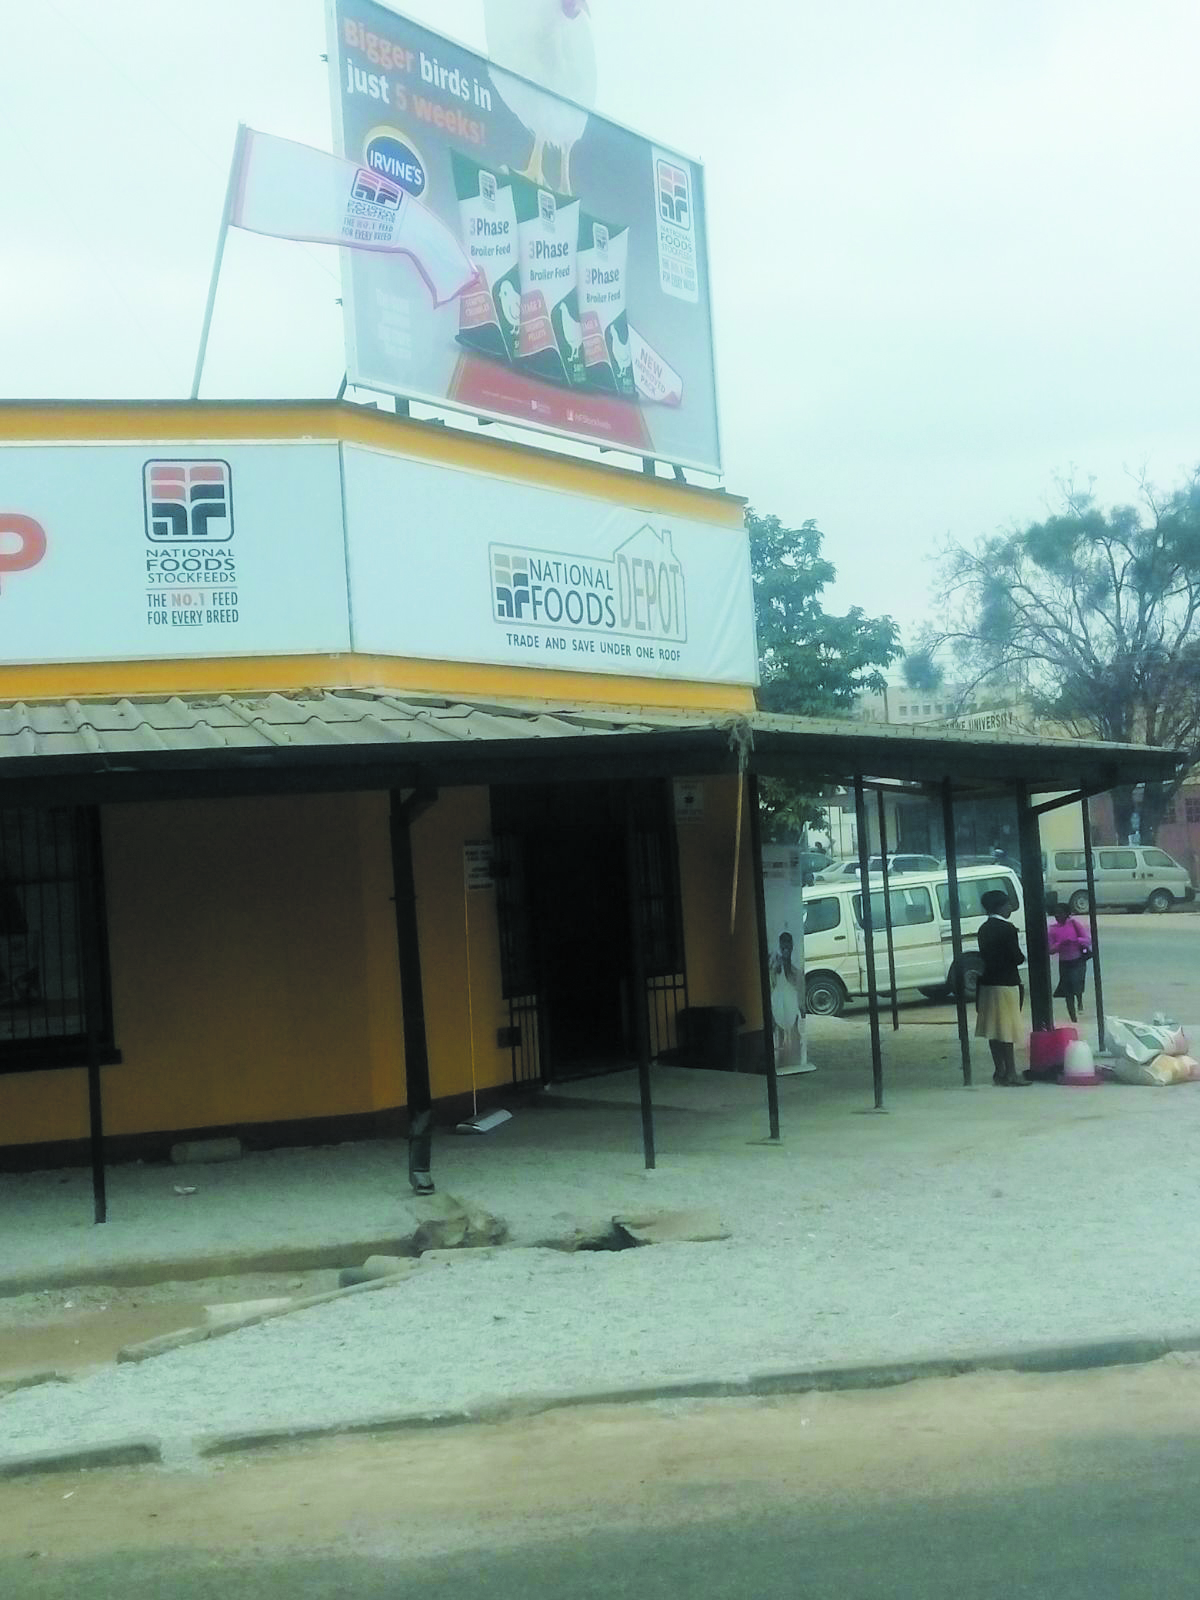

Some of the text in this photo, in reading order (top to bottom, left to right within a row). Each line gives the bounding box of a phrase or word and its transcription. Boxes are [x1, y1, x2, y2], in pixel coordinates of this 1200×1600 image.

[343, 17, 493, 111] Bigger birds in
[347, 58, 390, 104] just
[413, 91, 485, 144] weeks!
[370, 149, 423, 185] IRVINE'S
[146, 548, 235, 558] NATIONAL
[146, 559, 236, 572] FOODS
[148, 571, 236, 584] STOCKFEEDS
[529, 558, 614, 591] NATIONAL
[147, 593, 167, 608] THE
[212, 592, 238, 606] FEED
[531, 585, 616, 629] FOODS
[617, 553, 680, 635] DEPOT
[147, 609, 239, 625] FOR EVERY BREED
